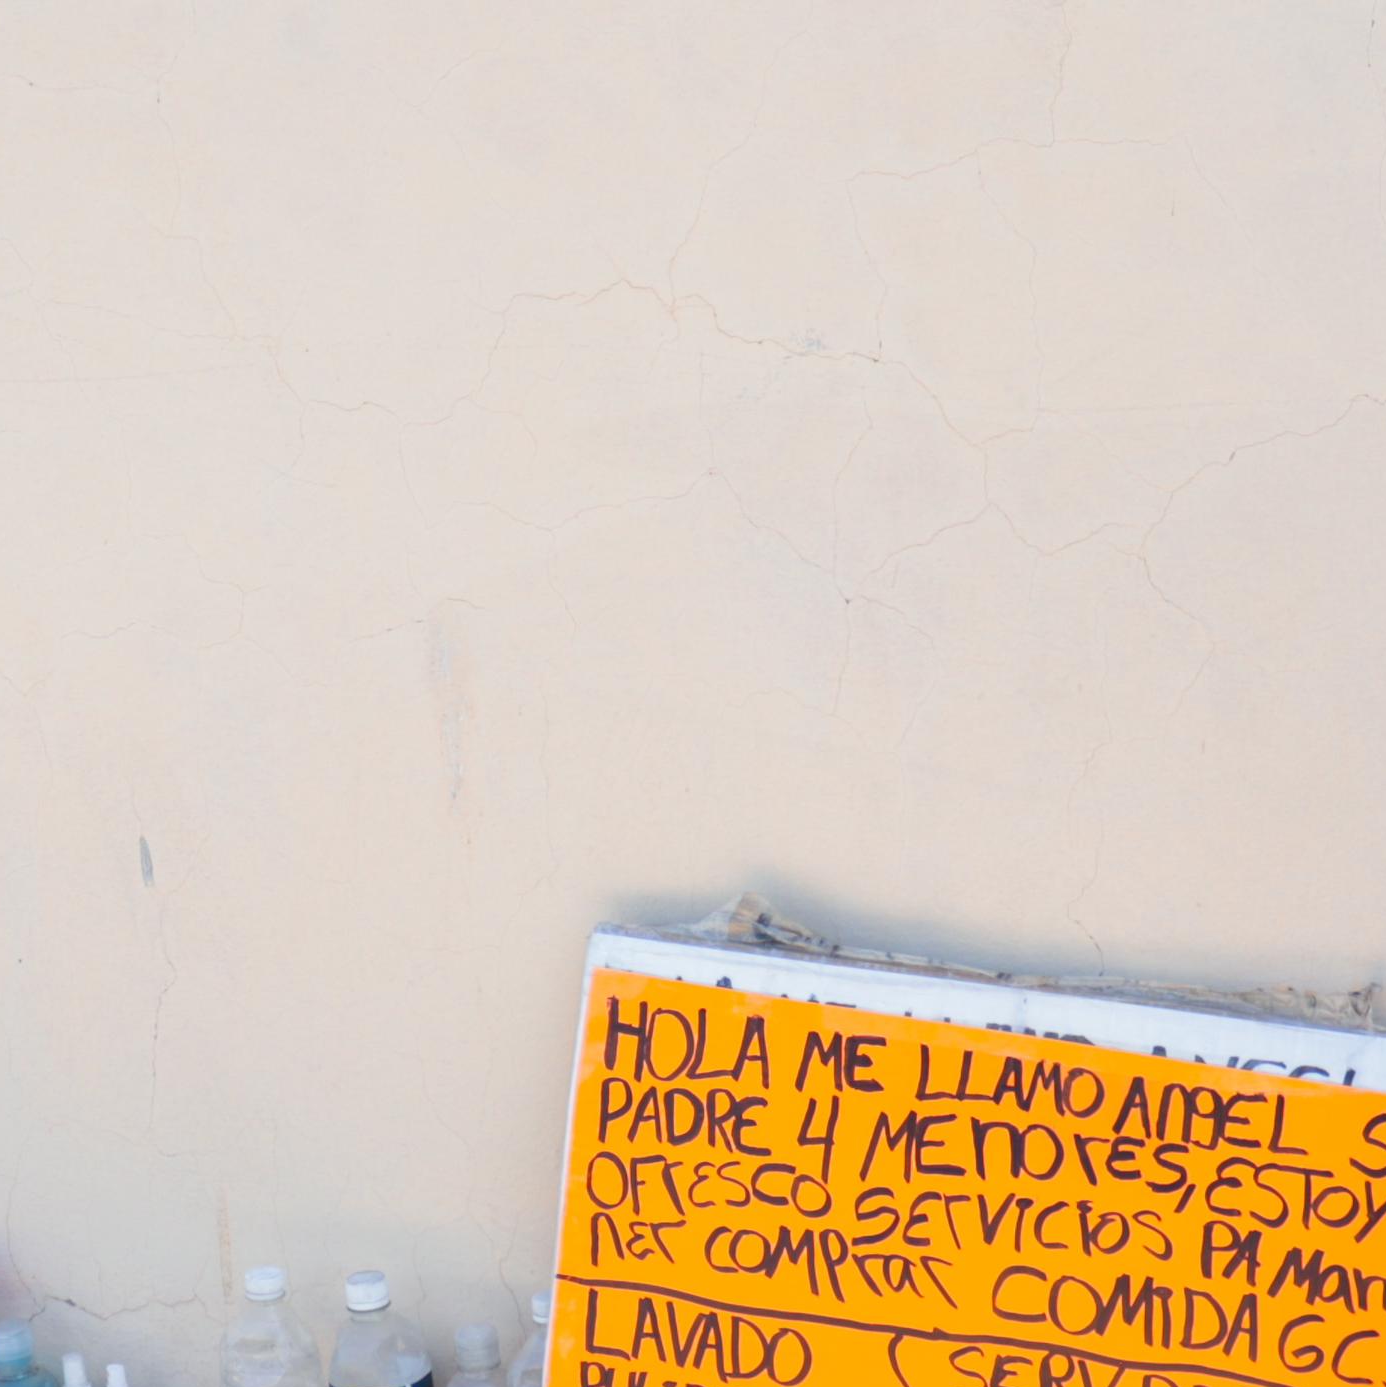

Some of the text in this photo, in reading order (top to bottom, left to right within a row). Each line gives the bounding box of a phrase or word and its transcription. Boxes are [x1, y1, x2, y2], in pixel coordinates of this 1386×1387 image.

[604, 996, 770, 1089] HOLA
[795, 1031, 887, 1092] ME
[915, 1043, 1105, 1118] LLAMO
[598, 1077, 772, 1156] PADRE
[797, 1095, 840, 1184] 4
[585, 1288, 812, 1387] LAVADO
